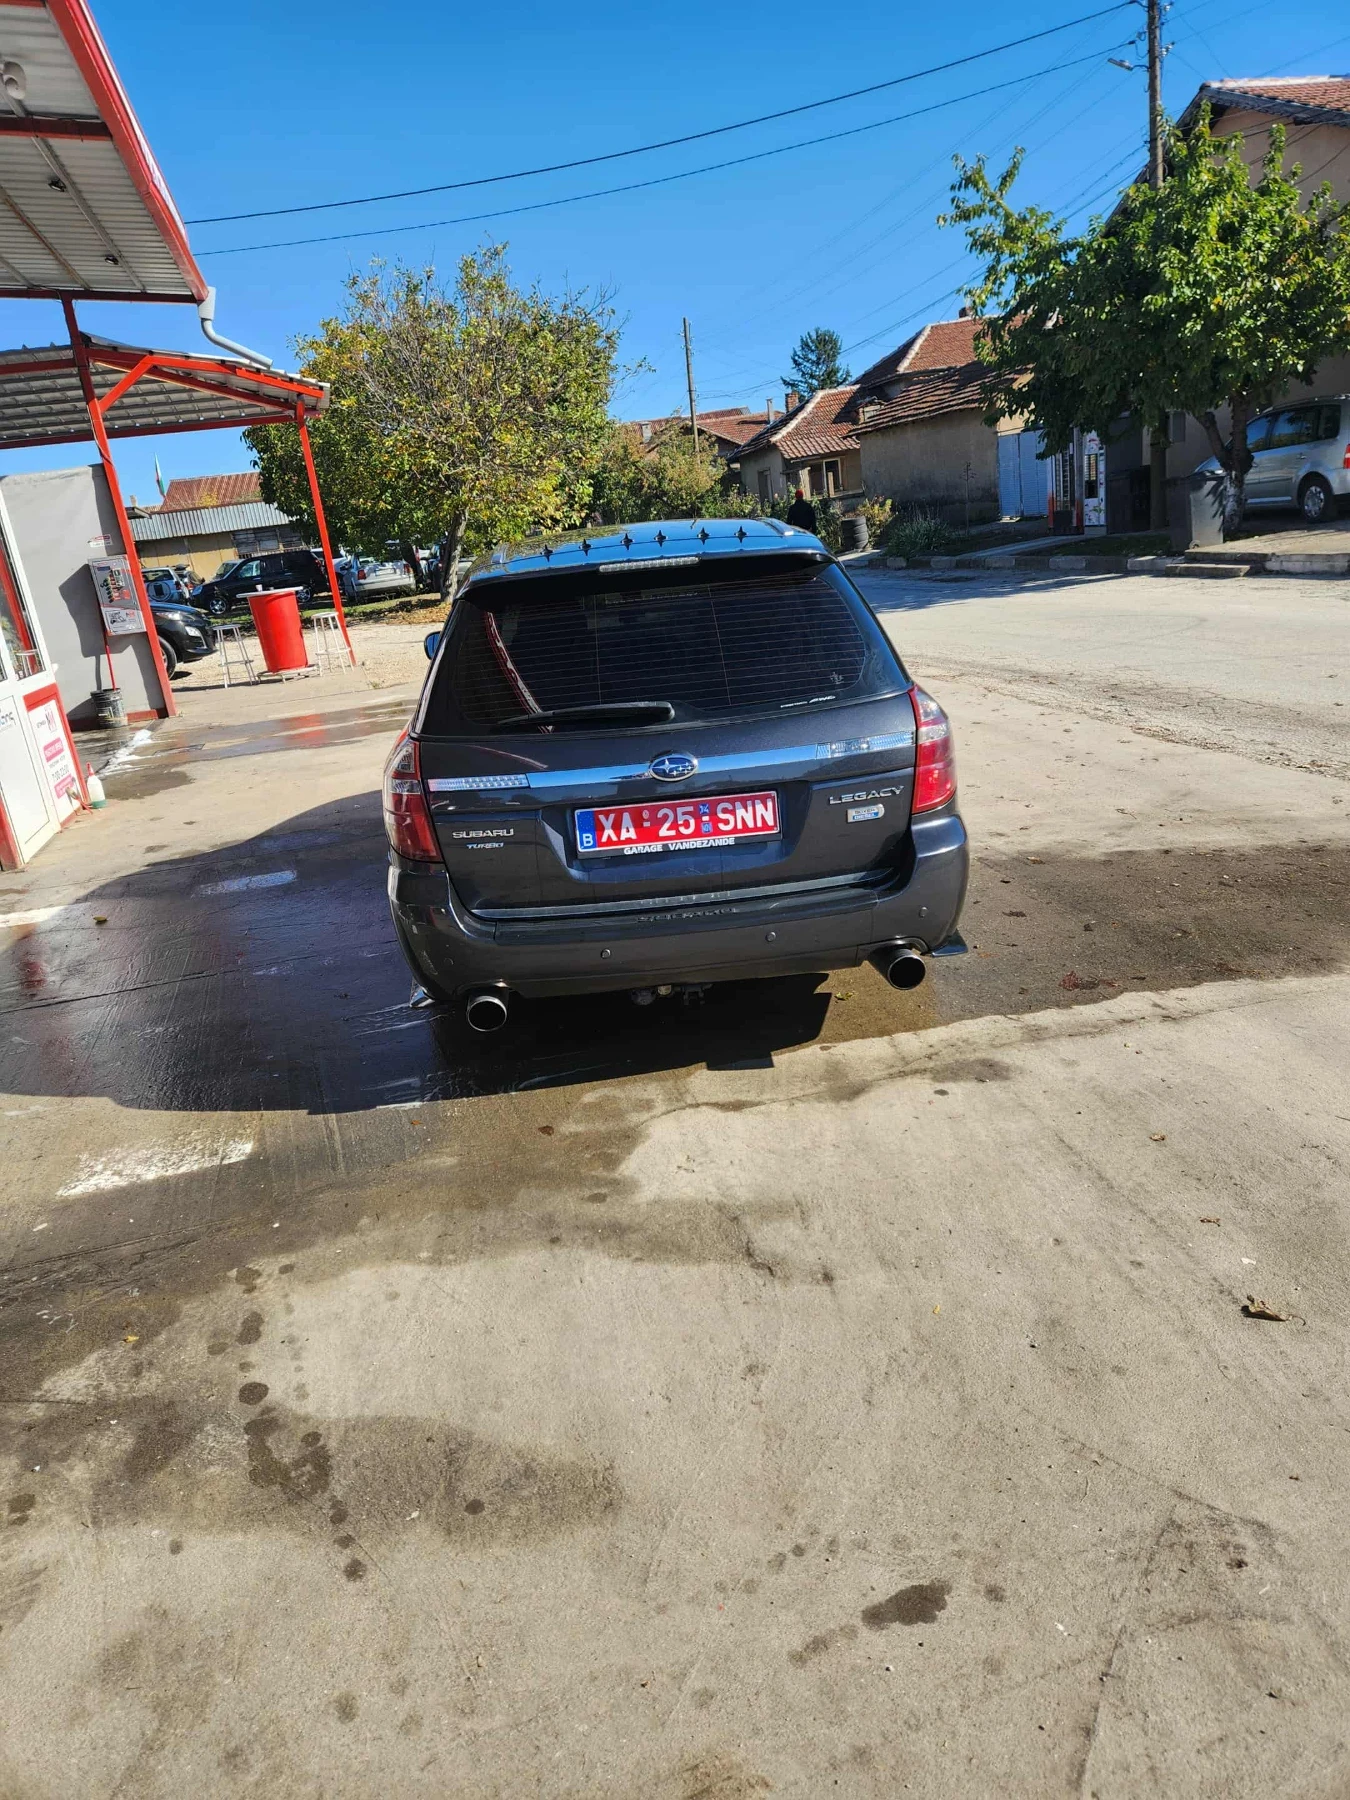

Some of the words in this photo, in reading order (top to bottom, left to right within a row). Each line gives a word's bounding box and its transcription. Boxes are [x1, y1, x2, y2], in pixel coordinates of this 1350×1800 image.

[829, 785, 905, 805] LEGACY
[452, 828, 514, 839] SUBARU
[582, 833, 594, 847] B
[624, 843, 663, 855] GARAGE
[668, 837, 735, 851] VANDEZANDE
